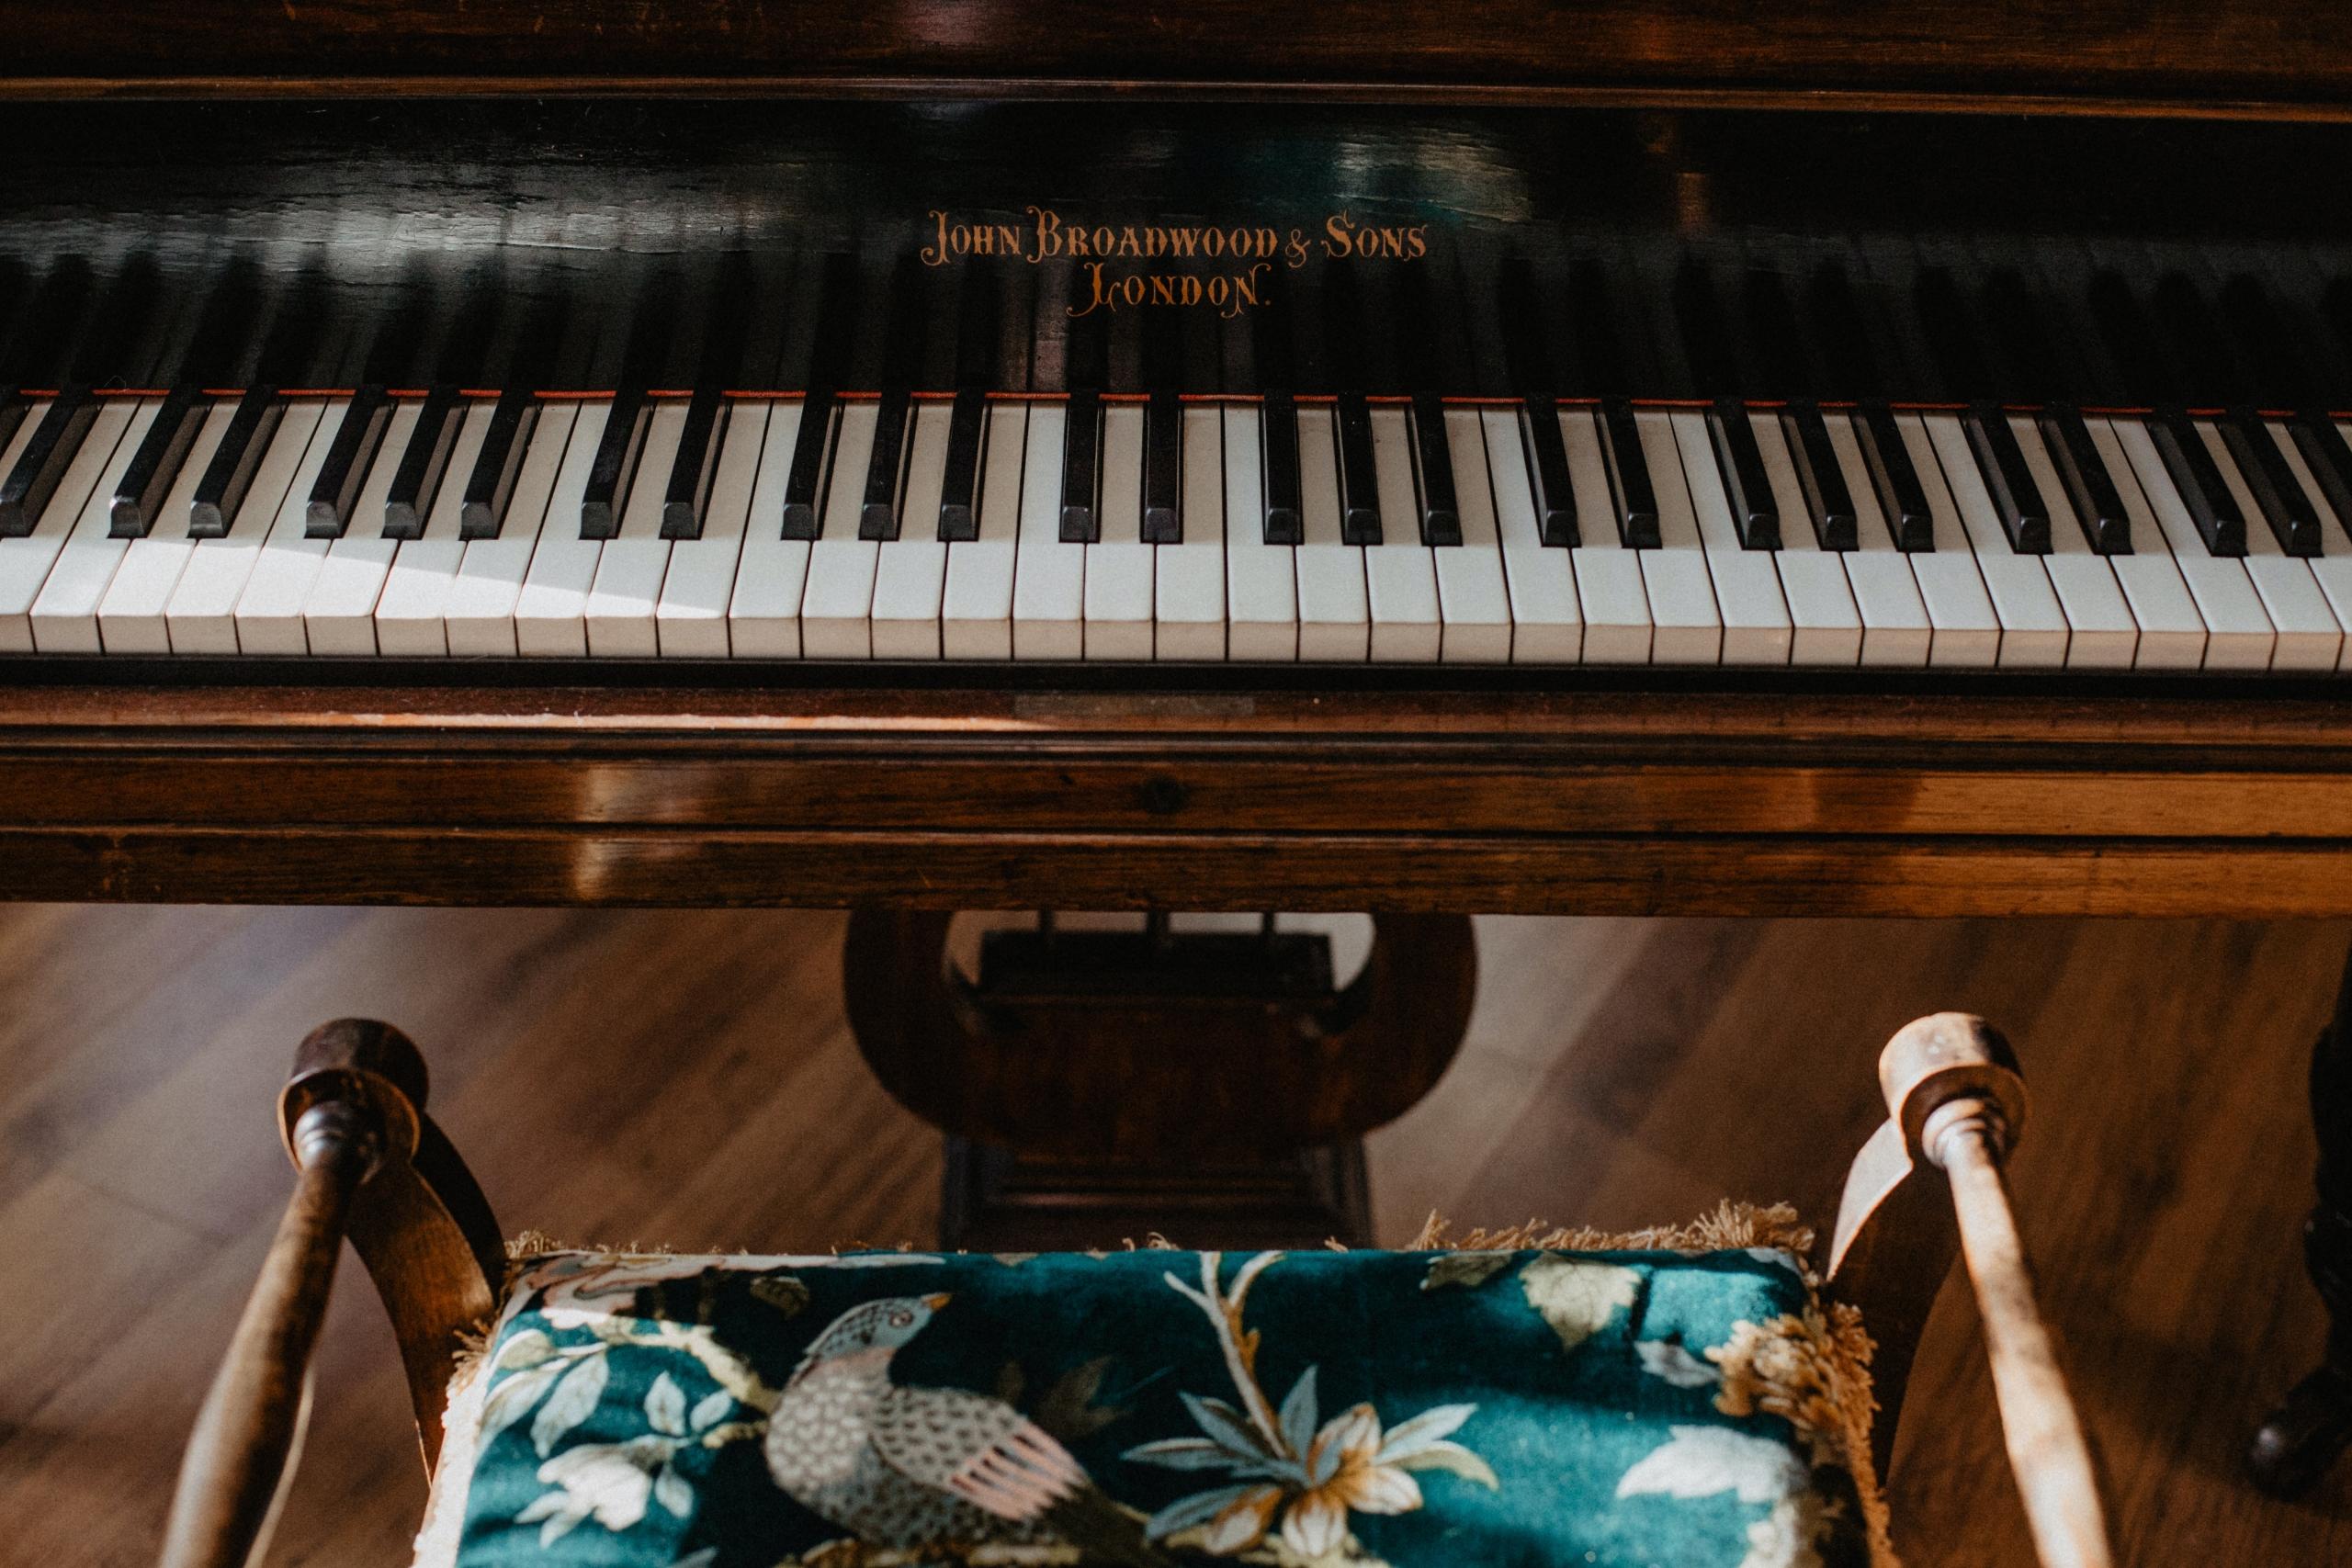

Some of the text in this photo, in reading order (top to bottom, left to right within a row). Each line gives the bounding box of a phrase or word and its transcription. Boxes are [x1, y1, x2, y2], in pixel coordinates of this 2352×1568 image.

[920, 205, 1428, 268] JOHN BROADWOOD & SONS
